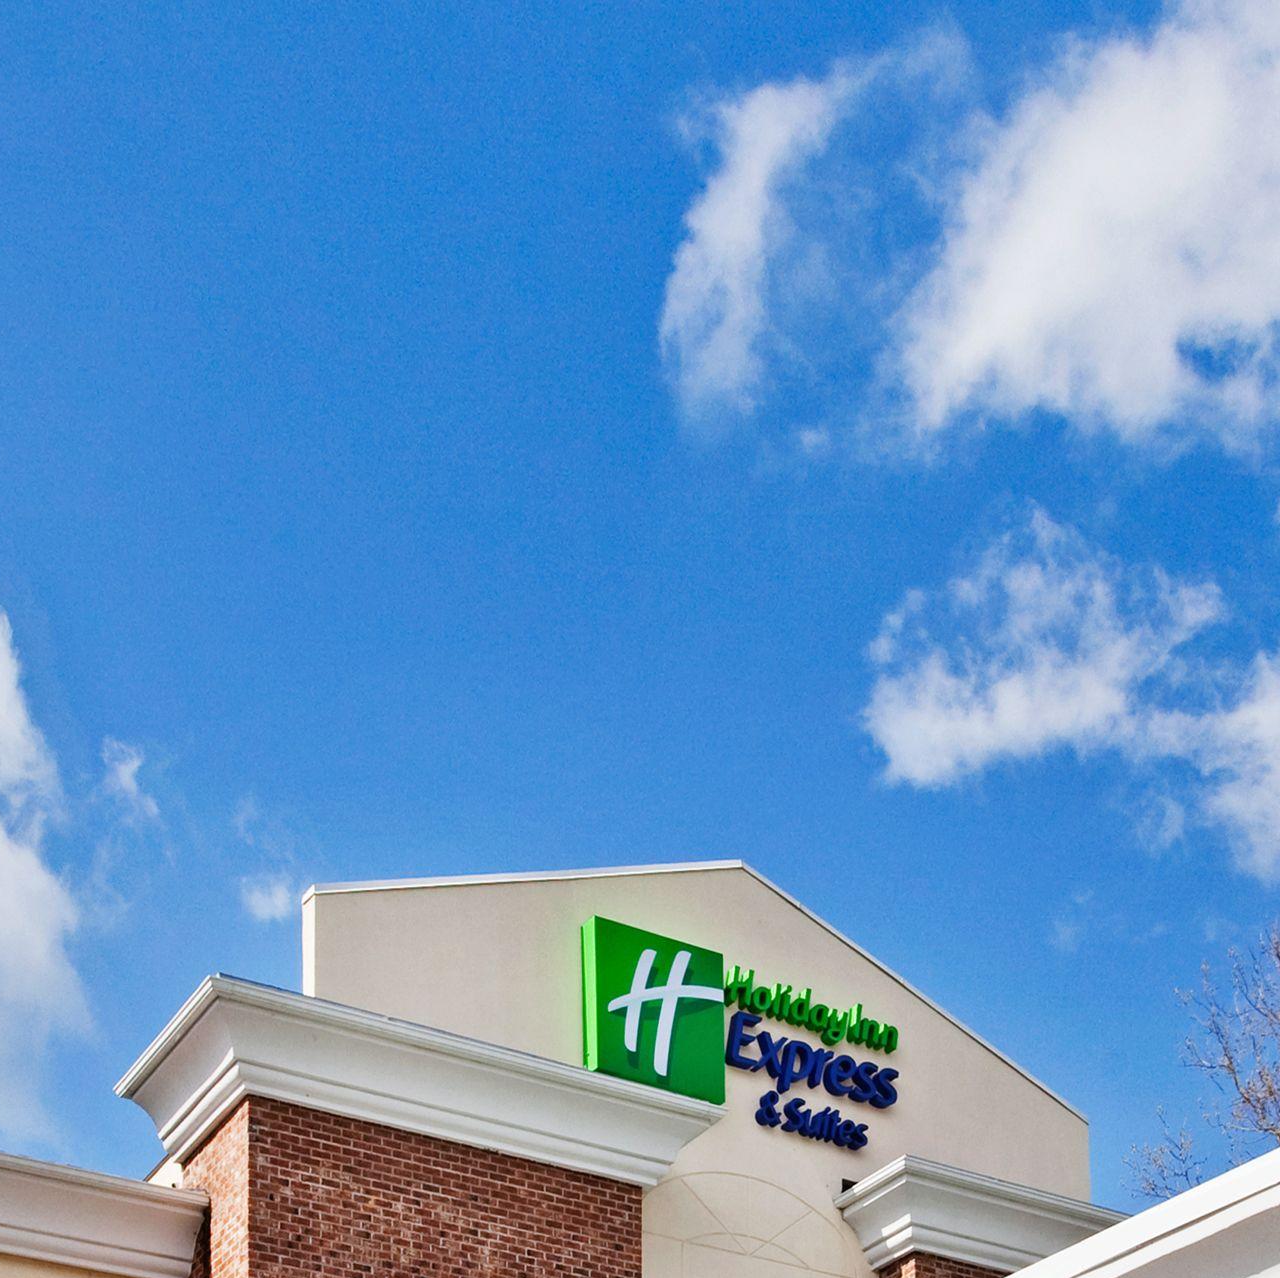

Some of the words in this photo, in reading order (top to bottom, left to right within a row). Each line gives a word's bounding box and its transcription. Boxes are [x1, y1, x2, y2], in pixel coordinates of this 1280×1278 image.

[724, 965, 848, 1046] Holiday
[847, 1003, 899, 1054] Inn
[725, 1011, 899, 1109] Express
[755, 1090, 782, 1128] &
[781, 1098, 869, 1150] Suites
